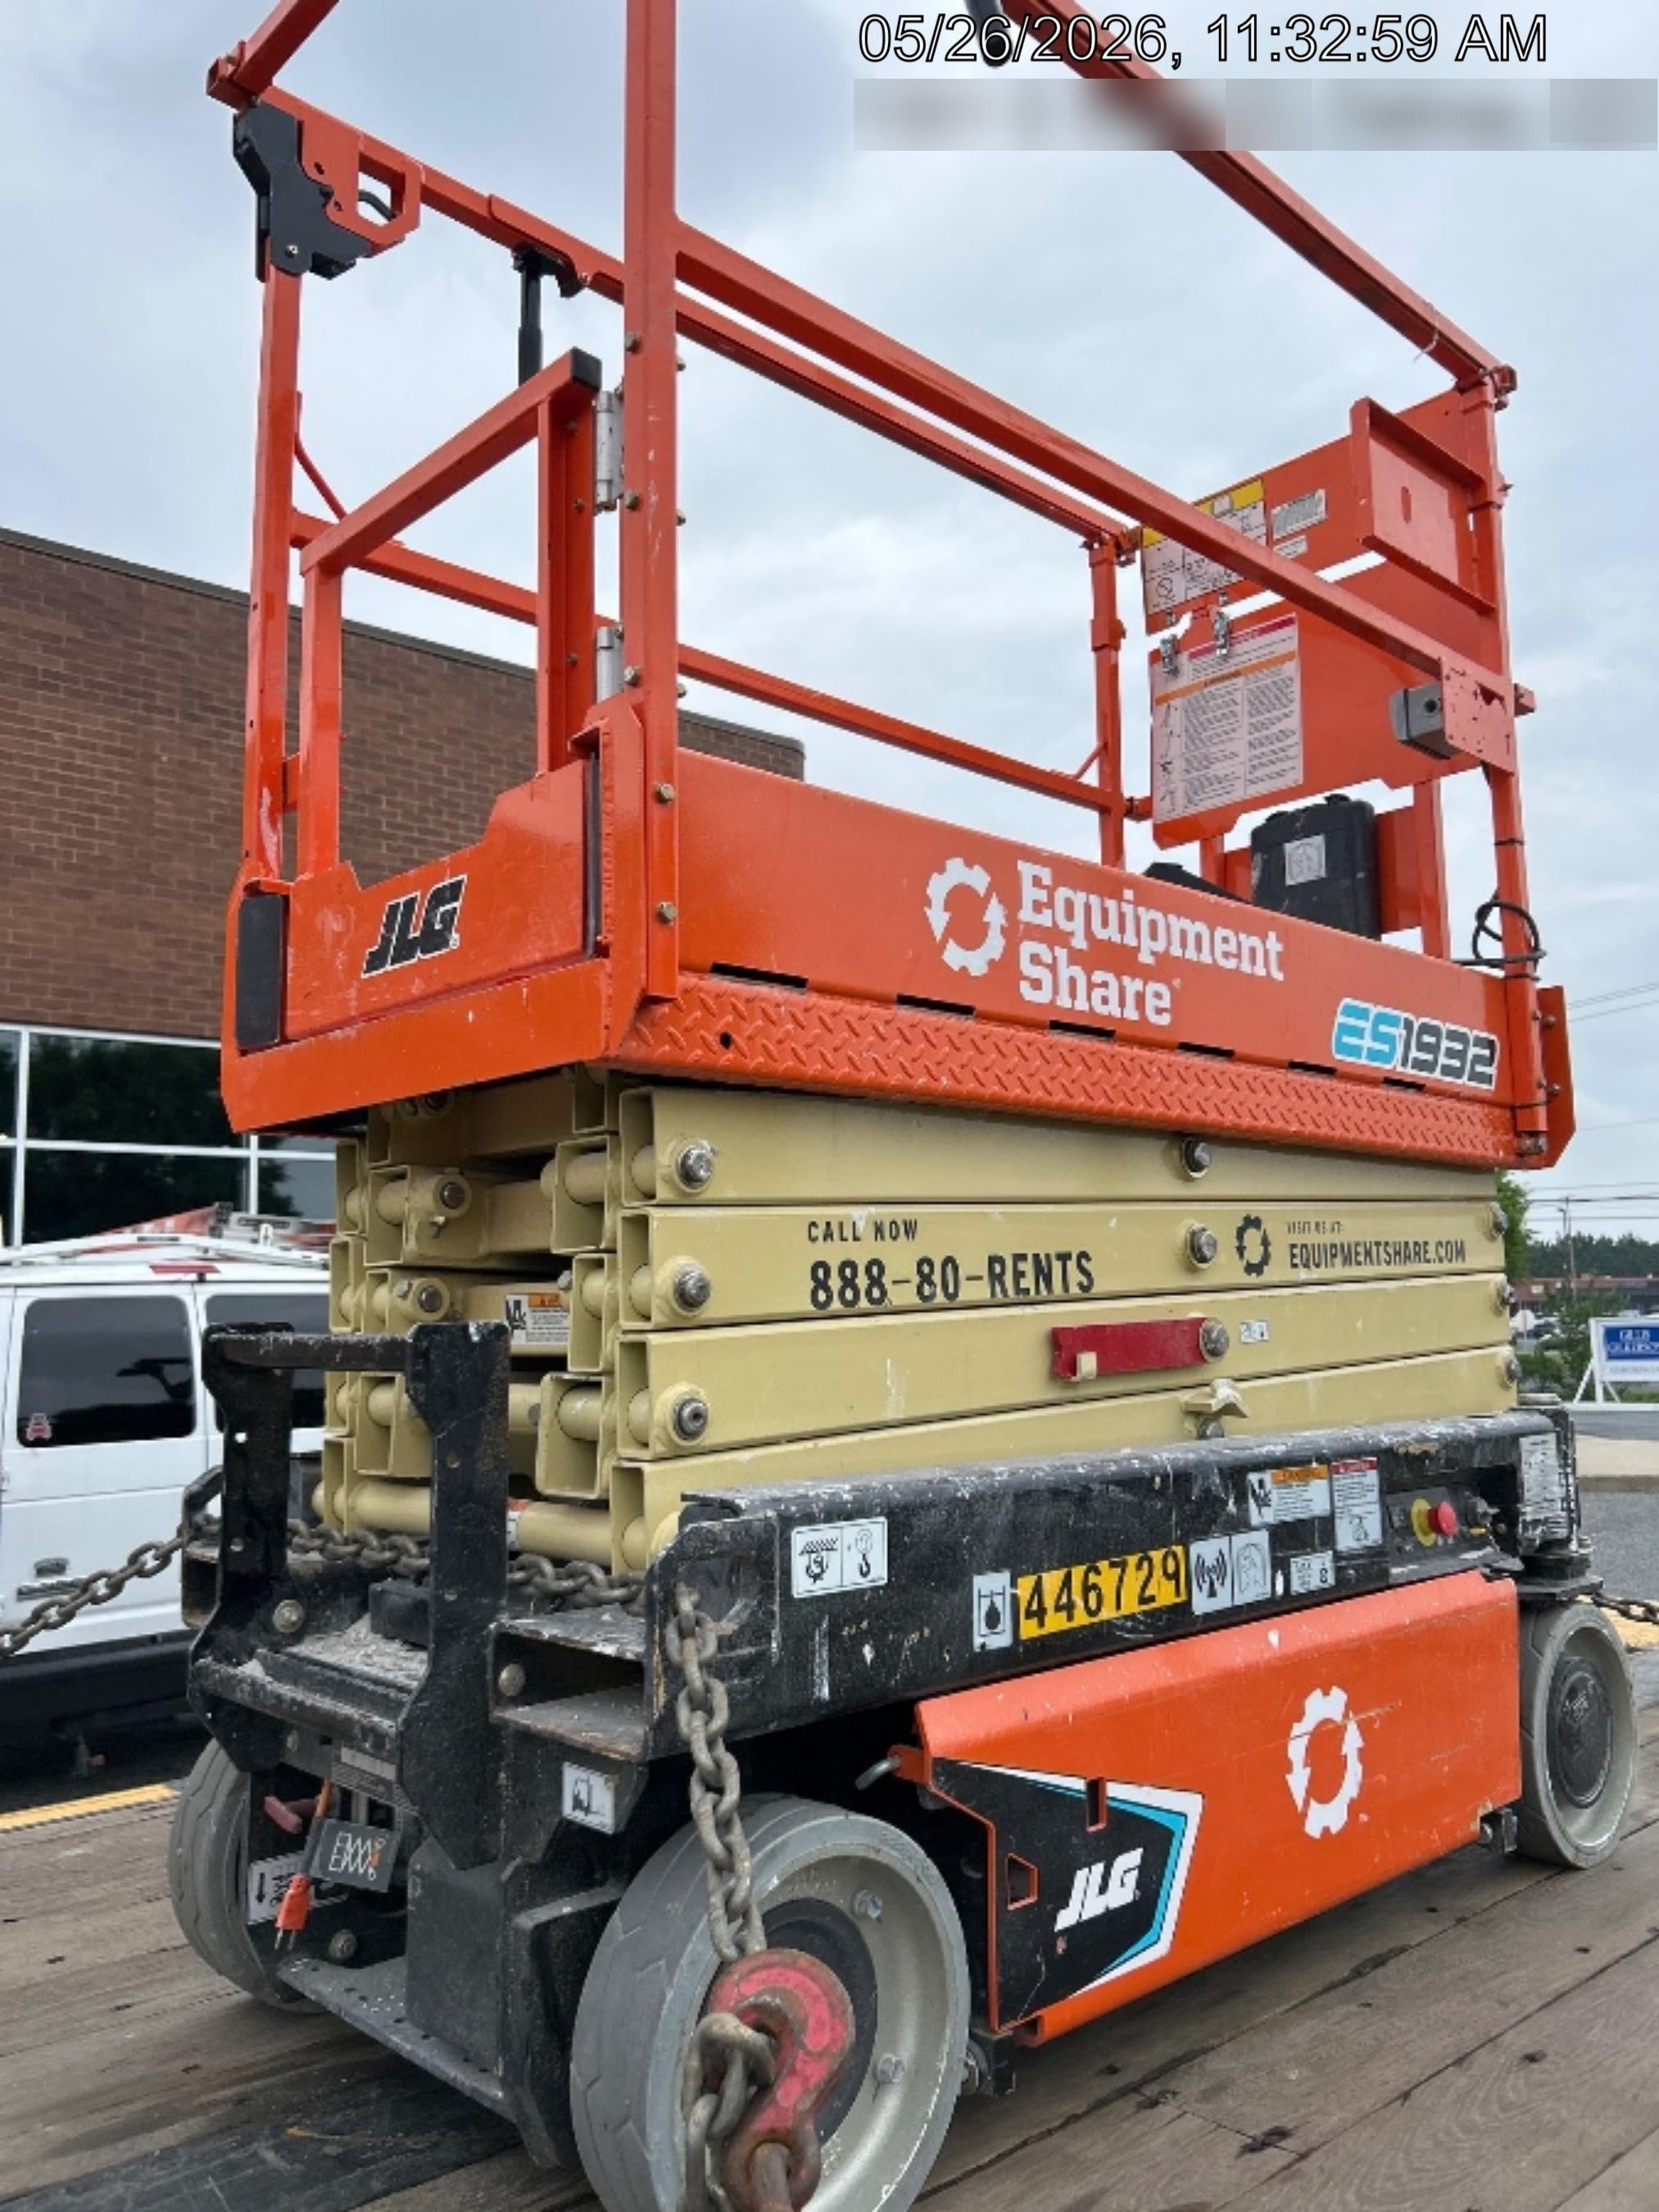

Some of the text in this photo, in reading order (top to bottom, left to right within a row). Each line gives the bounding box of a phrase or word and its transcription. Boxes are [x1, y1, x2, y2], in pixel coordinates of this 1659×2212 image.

[361, 873, 468, 978] JLG
[1018, 859, 1285, 981] Equipment
[1019, 941, 1172, 1026] Share
[1332, 998, 1499, 1090] ES1932
[808, 1218, 918, 1244] CALL NOW
[1290, 1240, 1466, 1269] EQUIPMENTSHARE.COM
[809, 1249, 1095, 1311] 888-80-RENTS
[1023, 1548, 1181, 1630] 446729
[1054, 1847, 1144, 1933] JLG
